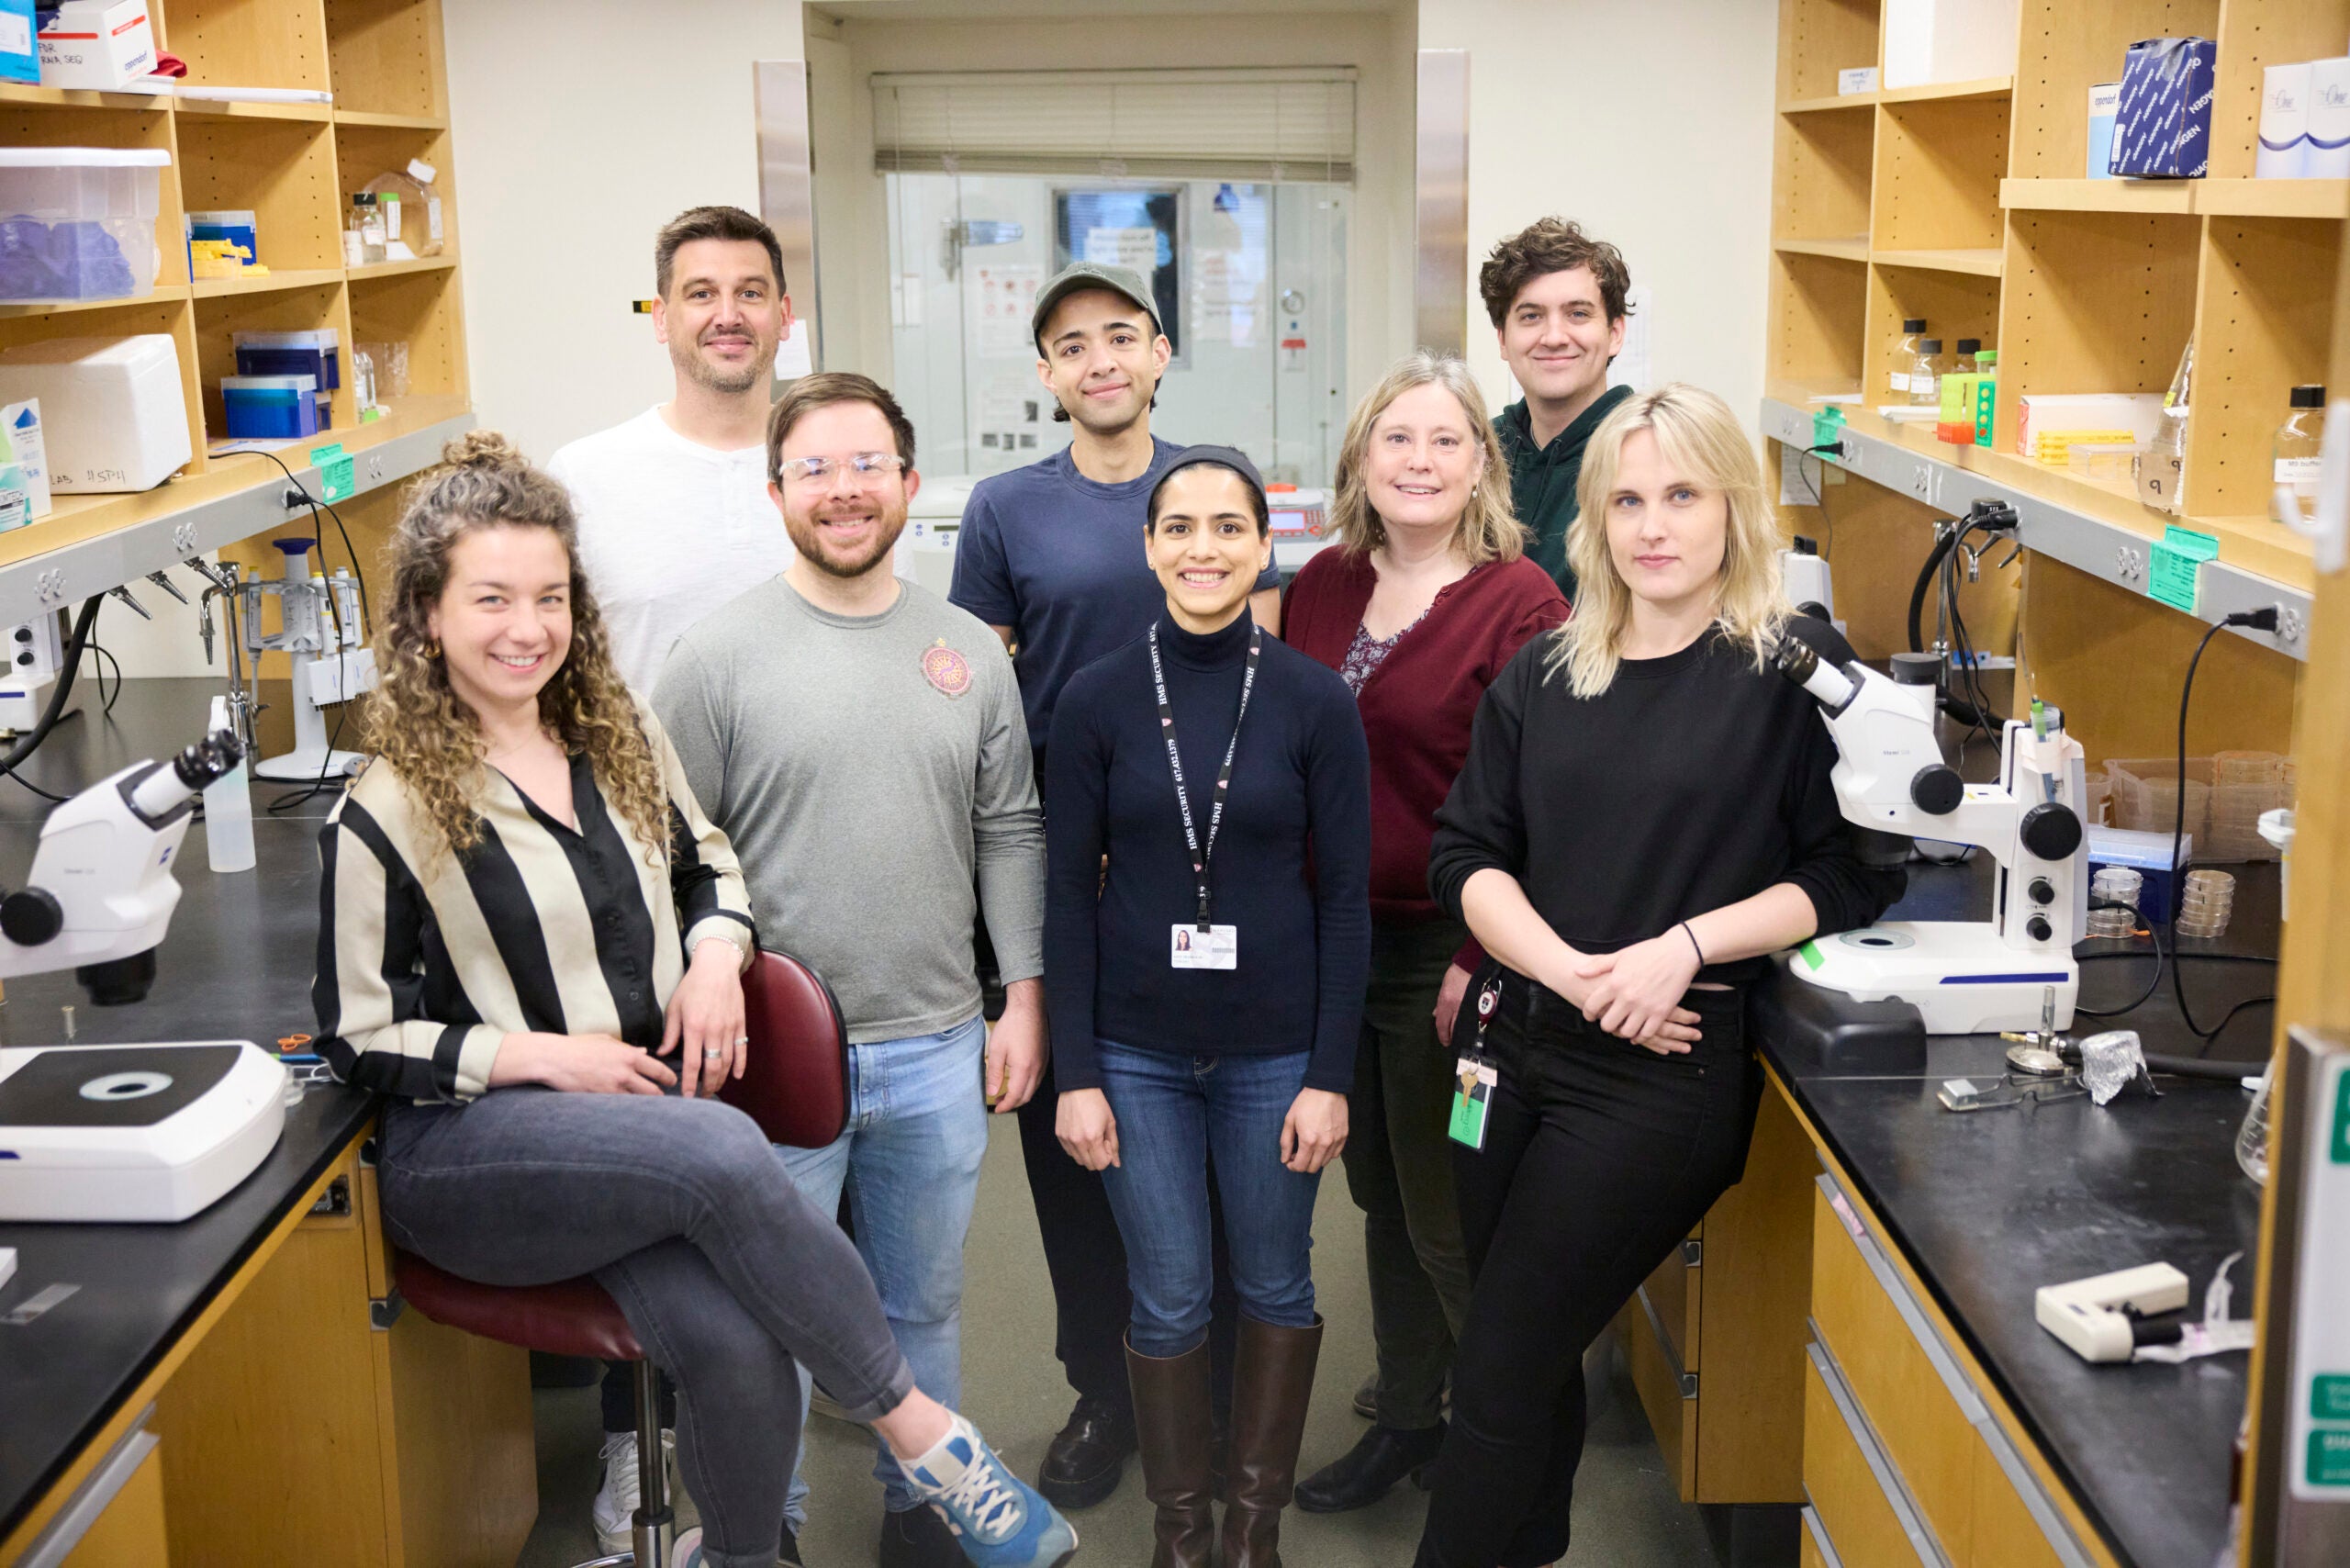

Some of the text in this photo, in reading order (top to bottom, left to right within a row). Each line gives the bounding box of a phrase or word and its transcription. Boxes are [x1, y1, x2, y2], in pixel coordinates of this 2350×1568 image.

[1150, 645, 1163, 684] SECURITY
[1245, 666, 1255, 688] HMS
[1157, 684, 1167, 705] HMS
[1167, 738, 1197, 850] HMS SECURITY 617.432.1379
[1212, 801, 1223, 824] HMS
